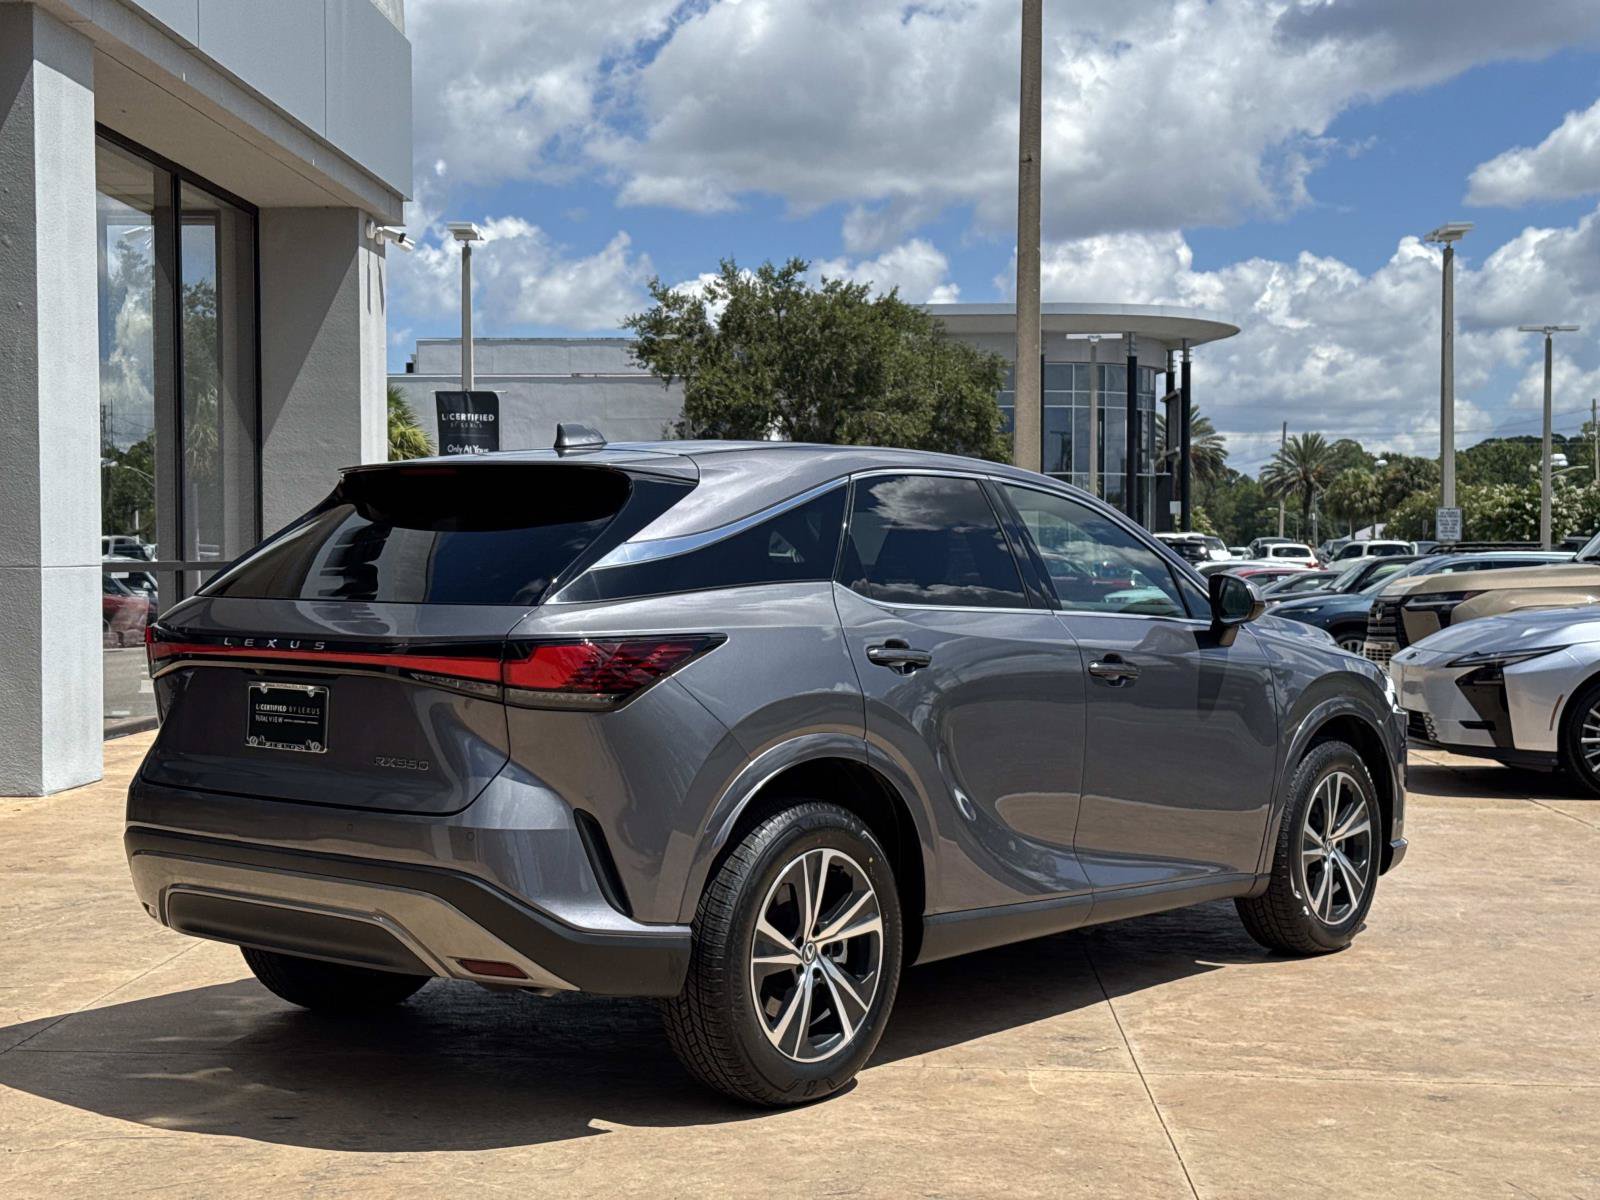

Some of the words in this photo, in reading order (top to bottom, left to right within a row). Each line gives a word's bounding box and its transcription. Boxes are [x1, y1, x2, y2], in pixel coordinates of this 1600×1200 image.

[447, 444, 463, 454] Only
[223, 636, 326, 650] LEXUS
[298, 706, 321, 715] LEXUS
